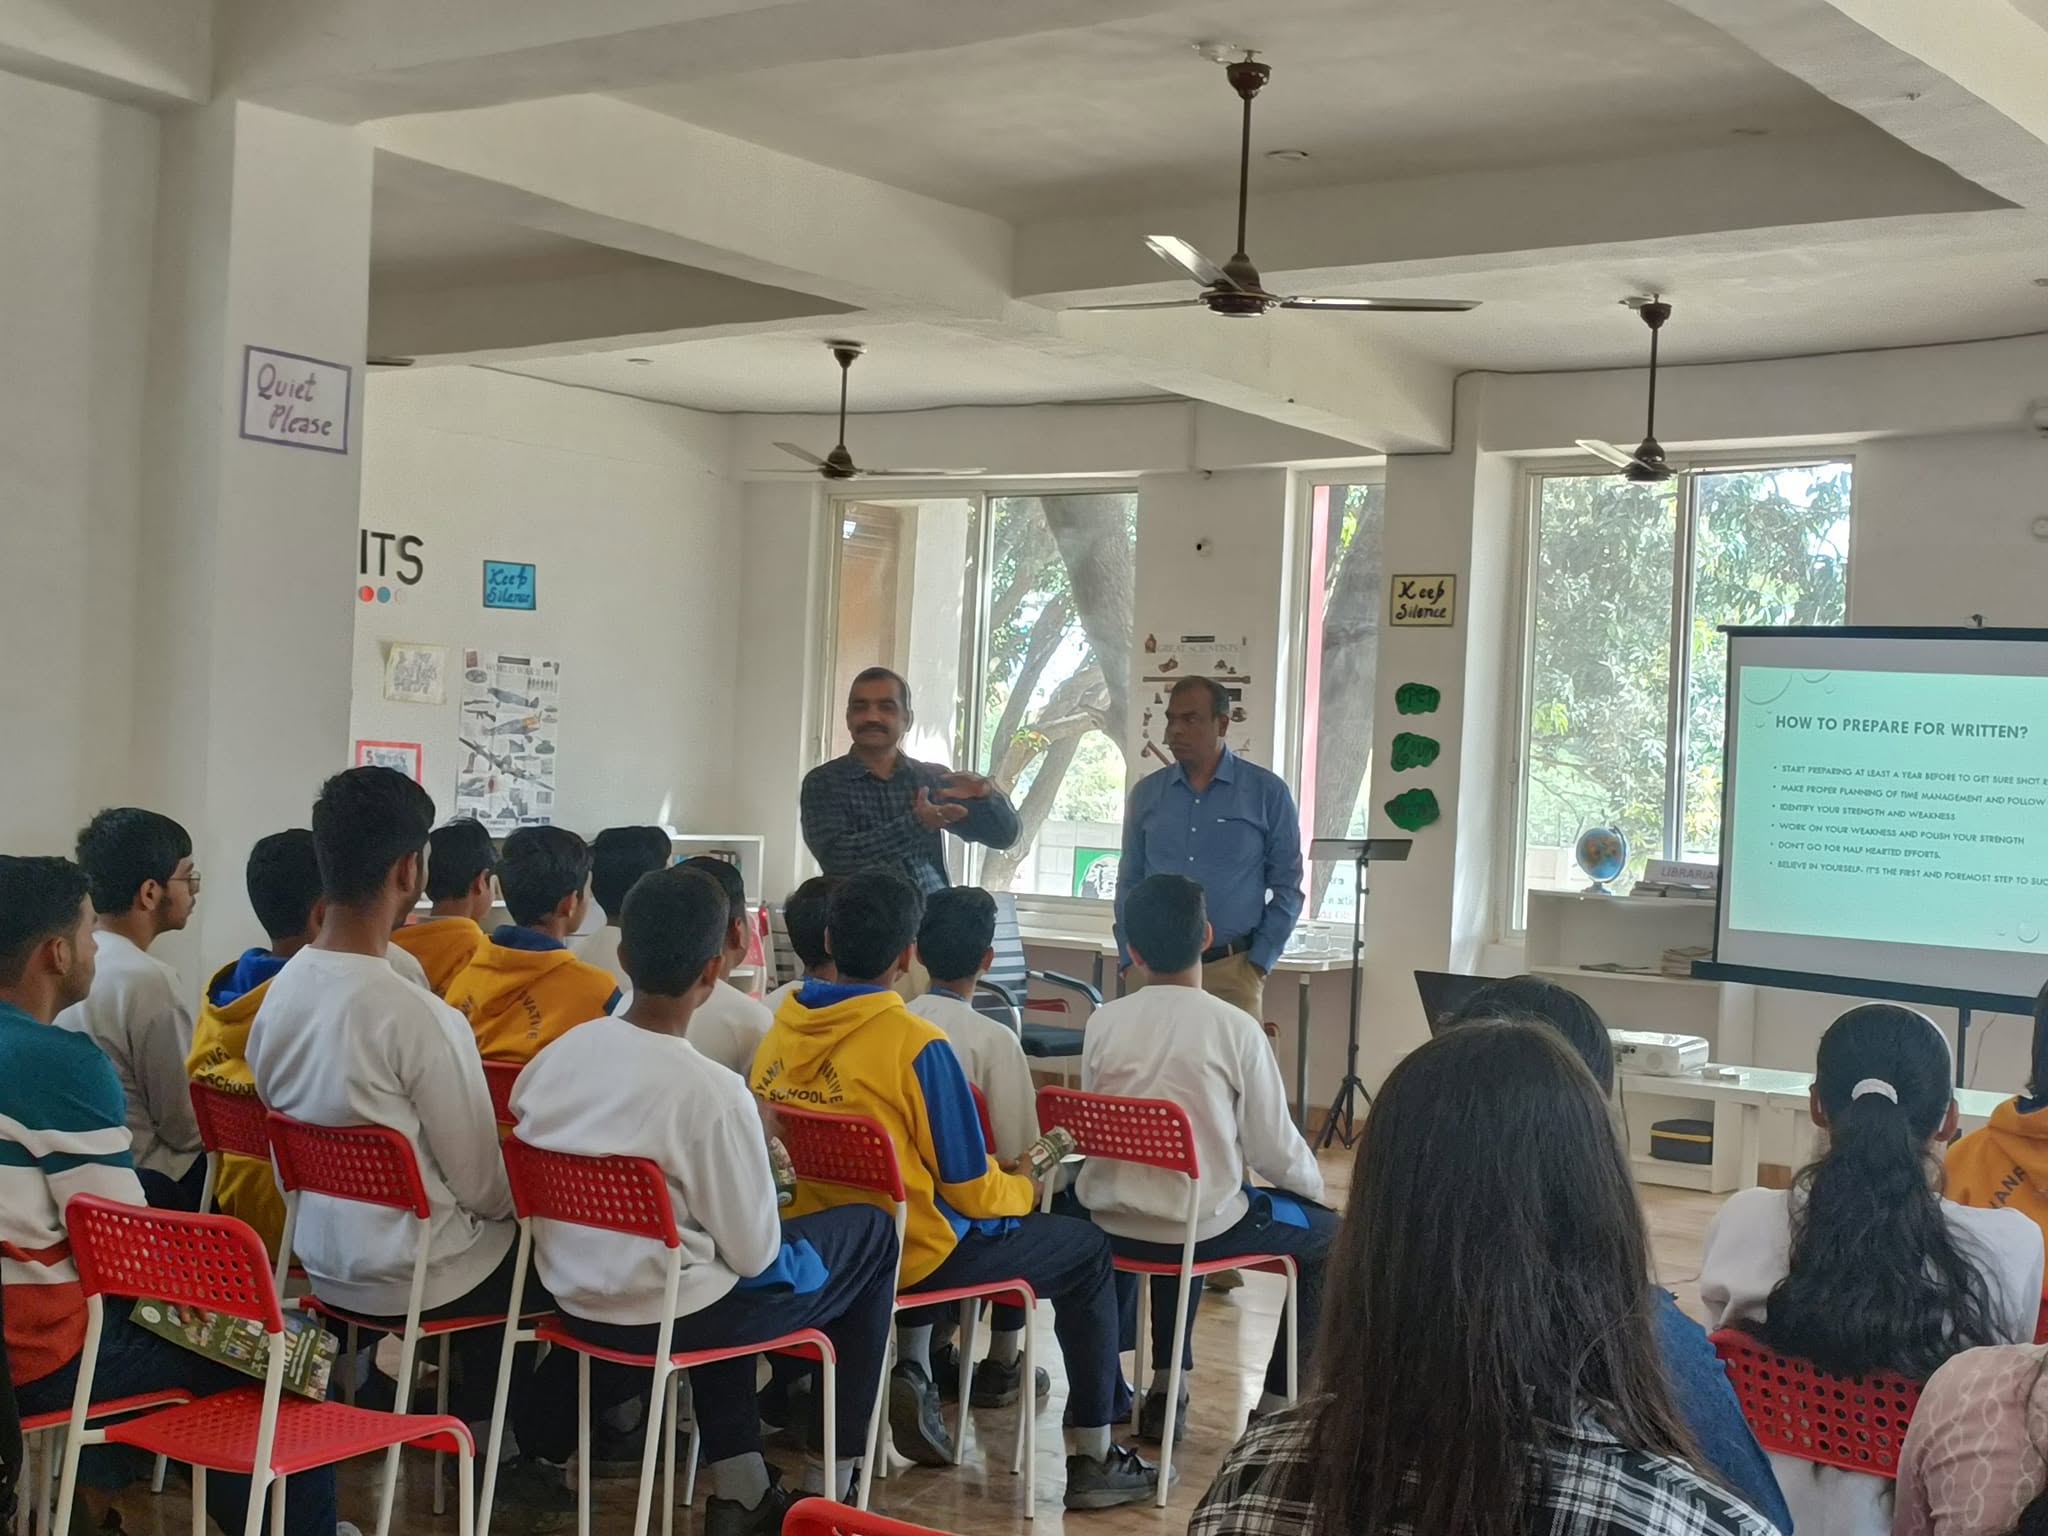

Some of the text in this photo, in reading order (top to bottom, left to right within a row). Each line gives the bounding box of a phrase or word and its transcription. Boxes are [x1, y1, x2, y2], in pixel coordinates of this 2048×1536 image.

[257, 363, 317, 402] Quiet
[269, 404, 333, 436] Please
[360, 529, 424, 586] ITS
[488, 566, 528, 590] Keep
[1398, 580, 1445, 605] Keep
[1396, 604, 1447, 620] Silence
[1775, 715, 2029, 739] HOW TO PREPARE FOR WRITTEN?
[1781, 765, 1806, 774] START
[1808, 766, 1853, 777] PREPARING
[1855, 769, 1865, 777] AT
[1867, 770, 1891, 778] LEAST
[1902, 771, 1923, 780] YEAR
[1925, 772, 1956, 782] BEFORE
[1958, 774, 1971, 783] TO
[1973, 775, 1990, 784] GET
[1993, 776, 2014, 785] SURE
[2016, 777, 2040, 785] SHOT
[1781, 785, 1804, 793] MAKE
[1806, 786, 1837, 795] PROPER
[1840, 787, 1884, 798] PLANNING
[1886, 790, 1898, 798] OF
[1900, 791, 1918, 800] TIME
[1985, 796, 2005, 804] AND
[2007, 797, 2047, 806] FOLLOW
[1780, 803, 1956, 821] IDENTIFY YOUR STRENGTH AND WEAKNESS
[1779, 822, 2025, 845] WORK ON YOUR WEAKNESS AND POLISH YOUR STRENGTH
[1807, 843, 1822, 852] GO
[1824, 844, 1841, 852] FOR
[1843, 845, 1863, 854] HALF
[1865, 847, 1902, 857] HEARTED
[1777, 860, 1807, 870] BELIEVE
[1809, 862, 1818, 870] IN
[1883, 867, 1897, 876] THE
[1899, 868, 1921, 878] FIRST
[1922, 871, 1942, 880] AND
[1944, 872, 1991, 882] FOREMOST
[1994, 875, 2014, 884] STEP
[2016, 876, 2029, 885] TO
[769, 1087, 828, 1105] SCHOOL
